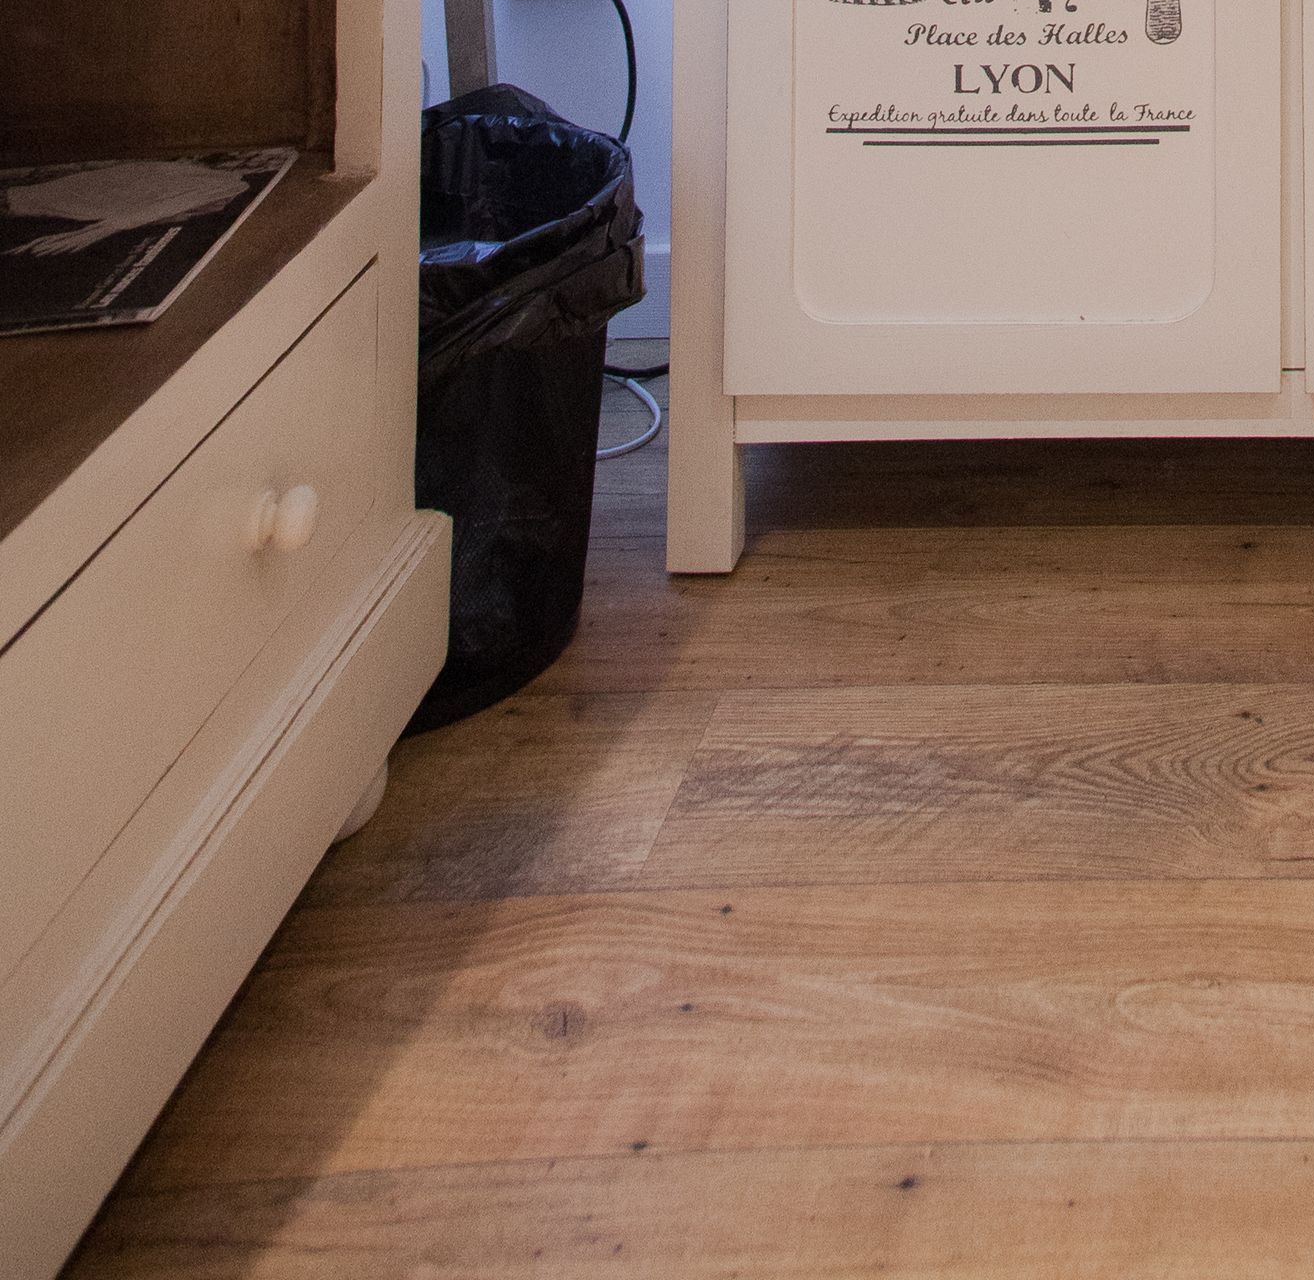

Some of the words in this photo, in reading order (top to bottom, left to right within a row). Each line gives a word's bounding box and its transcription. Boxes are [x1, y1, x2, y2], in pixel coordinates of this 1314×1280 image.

[904, 24, 977, 45] Place
[987, 25, 1026, 45] des
[1038, 23, 1127, 45] Halles
[954, 64, 1075, 94] LYON
[828, 104, 922, 126] Expedition
[928, 105, 1000, 126] gratuite
[1006, 104, 1049, 122] dans
[1055, 104, 1099, 122] toute
[1110, 102, 1128, 121] la
[1134, 104, 1195, 121] France
